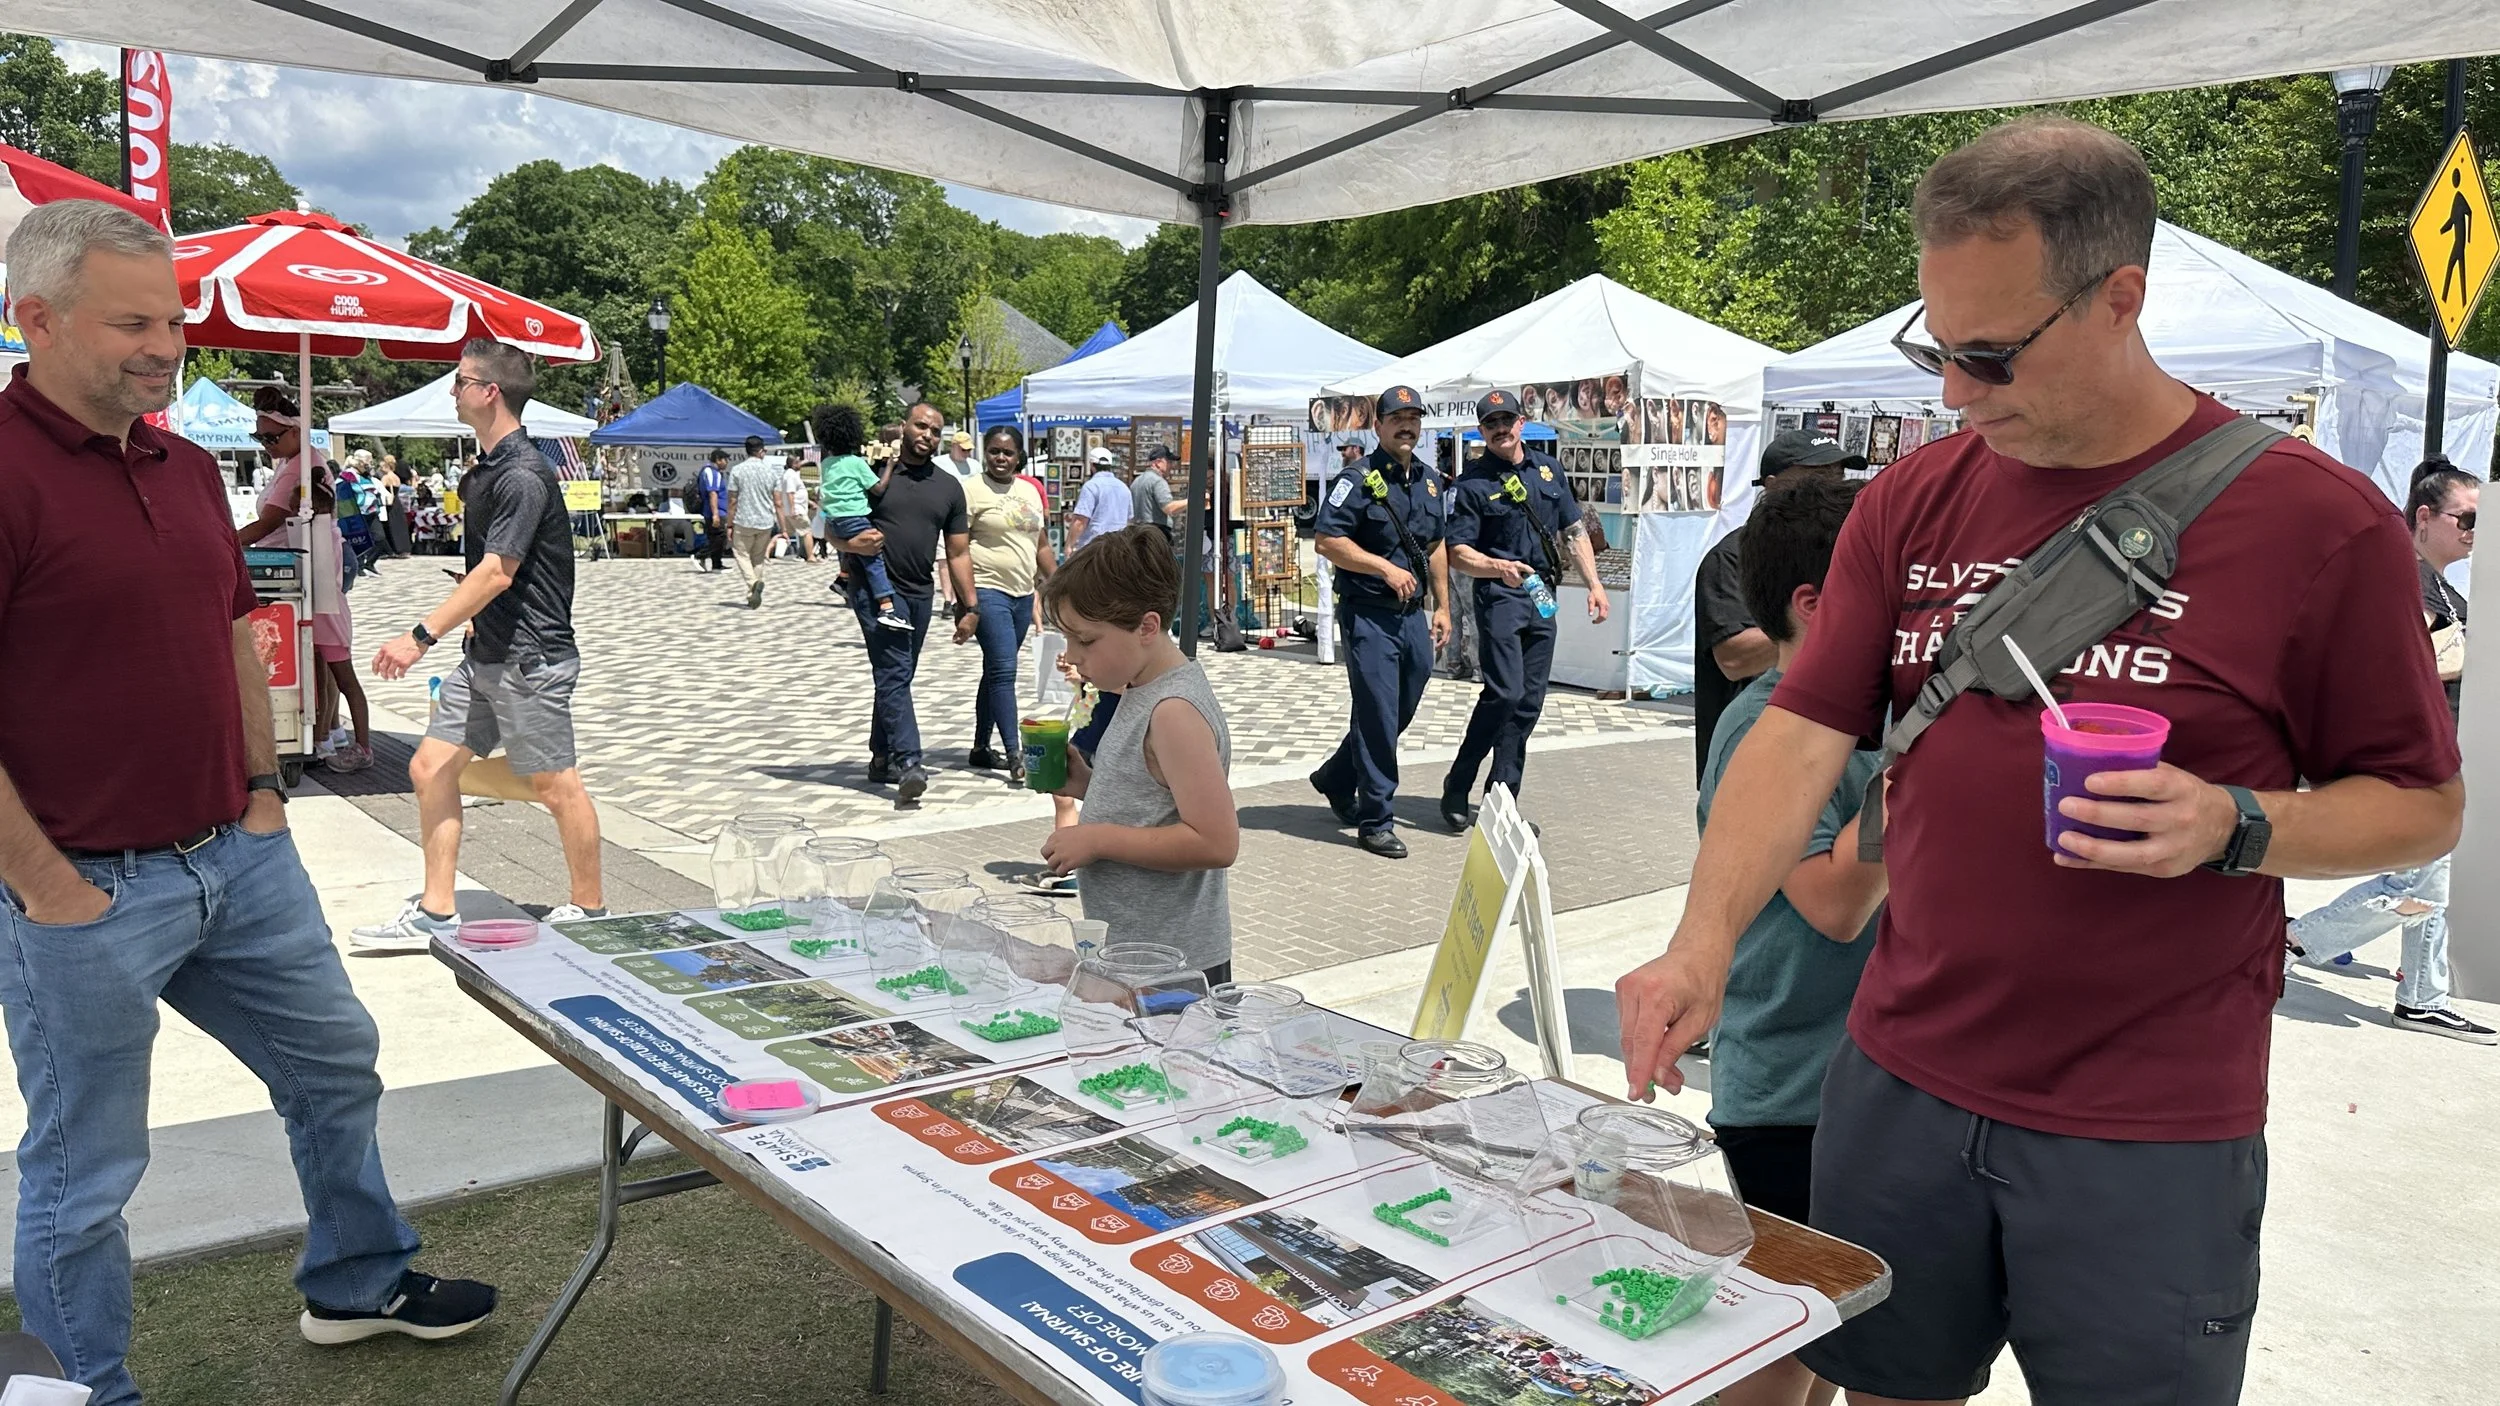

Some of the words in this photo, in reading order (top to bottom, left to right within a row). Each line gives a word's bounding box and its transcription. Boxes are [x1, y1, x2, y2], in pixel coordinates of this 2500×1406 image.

[334, 295, 359, 307] GOOD
[1447, 400, 1477, 417] PIER
[188, 433, 243, 443] SMYRNA
[638, 449, 687, 461] JONQUIL
[1678, 448, 1698, 462] Hole
[614, 1015, 640, 1029] OF?
[612, 1032, 635, 1045] OF
[628, 1023, 659, 1042] MORE
[625, 1040, 663, 1064] FUTURE
[650, 1058, 677, 1074] THE
[747, 1132, 798, 1162] SHAPE
[768, 1128, 816, 1157] SMYRNA
[929, 1181, 943, 1190] in
[936, 1186, 952, 1196] of
[948, 1191, 976, 1209] more
[971, 1206, 991, 1218] see
[986, 1216, 1001, 1225] to
[997, 1222, 1018, 1235] like
[1028, 1223, 1050, 1237] way
[1047, 1234, 1072, 1250] any
[1040, 1247, 1075, 1270] things
[1064, 1247, 1098, 1268] beads
[1067, 1266, 1087, 1279] of
[1093, 1265, 1115, 1280] the
[1083, 1273, 1116, 1294] types
[1292, 1270, 1350, 1310] continuum
[1110, 1276, 1165, 1309] distribute
[1716, 1293, 1739, 1307] Mo
[1109, 1291, 1142, 1312] what
[1065, 1303, 1105, 1327] OF?
[1138, 1308, 1156, 1319] us
[1161, 1305, 1186, 1321] can
[1024, 1302, 1095, 1343] SMYRNA!
[1149, 1316, 1175, 1333] tell
[1095, 1320, 1149, 1356] MORE
[1082, 1346, 1121, 1365] OF
[1109, 1360, 1143, 1387] URE
